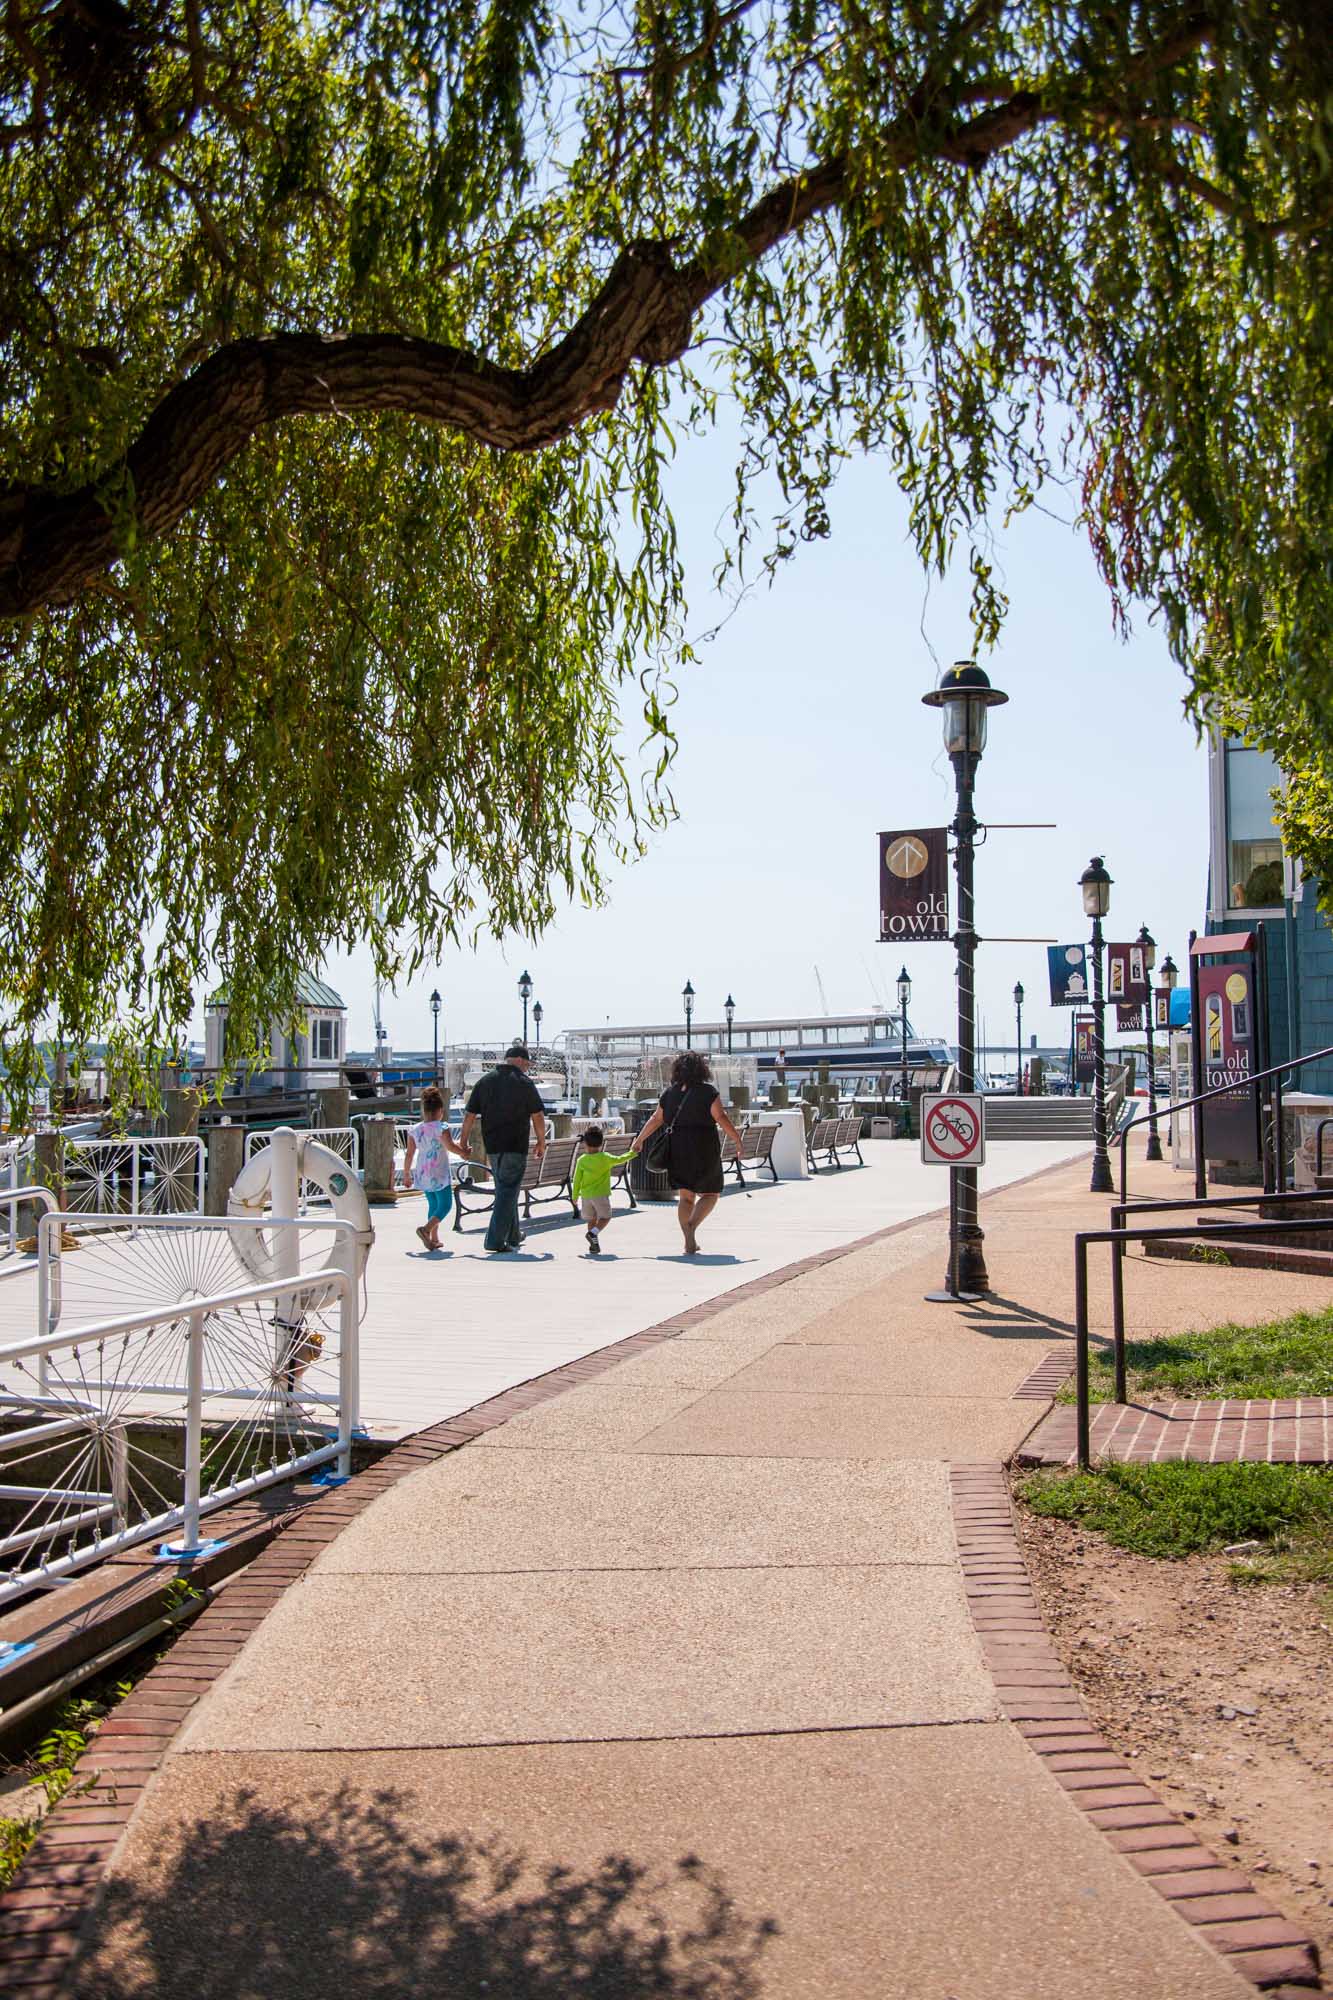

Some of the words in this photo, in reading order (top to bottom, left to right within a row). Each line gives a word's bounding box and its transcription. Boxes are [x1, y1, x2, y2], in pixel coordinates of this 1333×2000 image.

[916, 893, 948, 914] old
[880, 910, 948, 934] town
[1227, 1049, 1249, 1069] old
[1206, 1065, 1250, 1087] town
